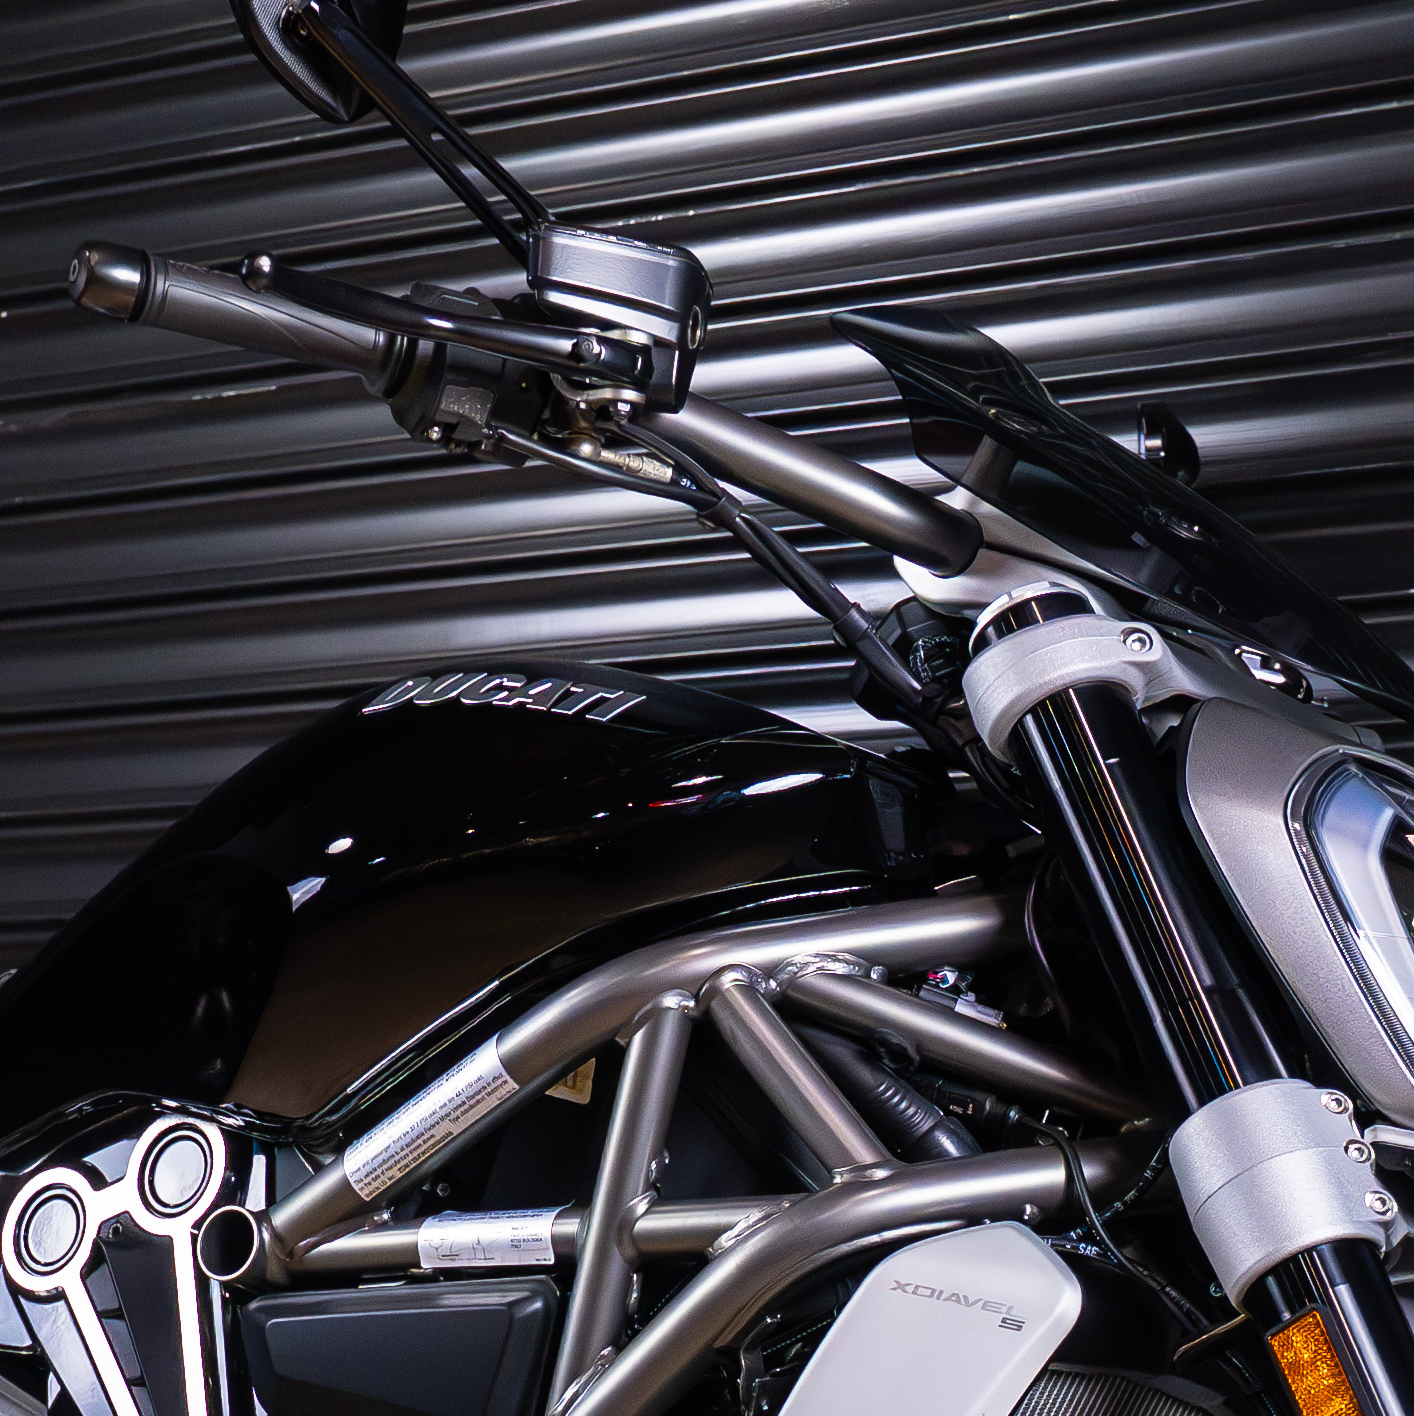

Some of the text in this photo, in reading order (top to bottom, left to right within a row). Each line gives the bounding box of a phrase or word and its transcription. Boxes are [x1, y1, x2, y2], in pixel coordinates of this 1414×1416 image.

[361, 672, 646, 722] DUCATI
[889, 1279, 1027, 1321] XDIAVEL
[998, 1317, 1025, 1332] S
